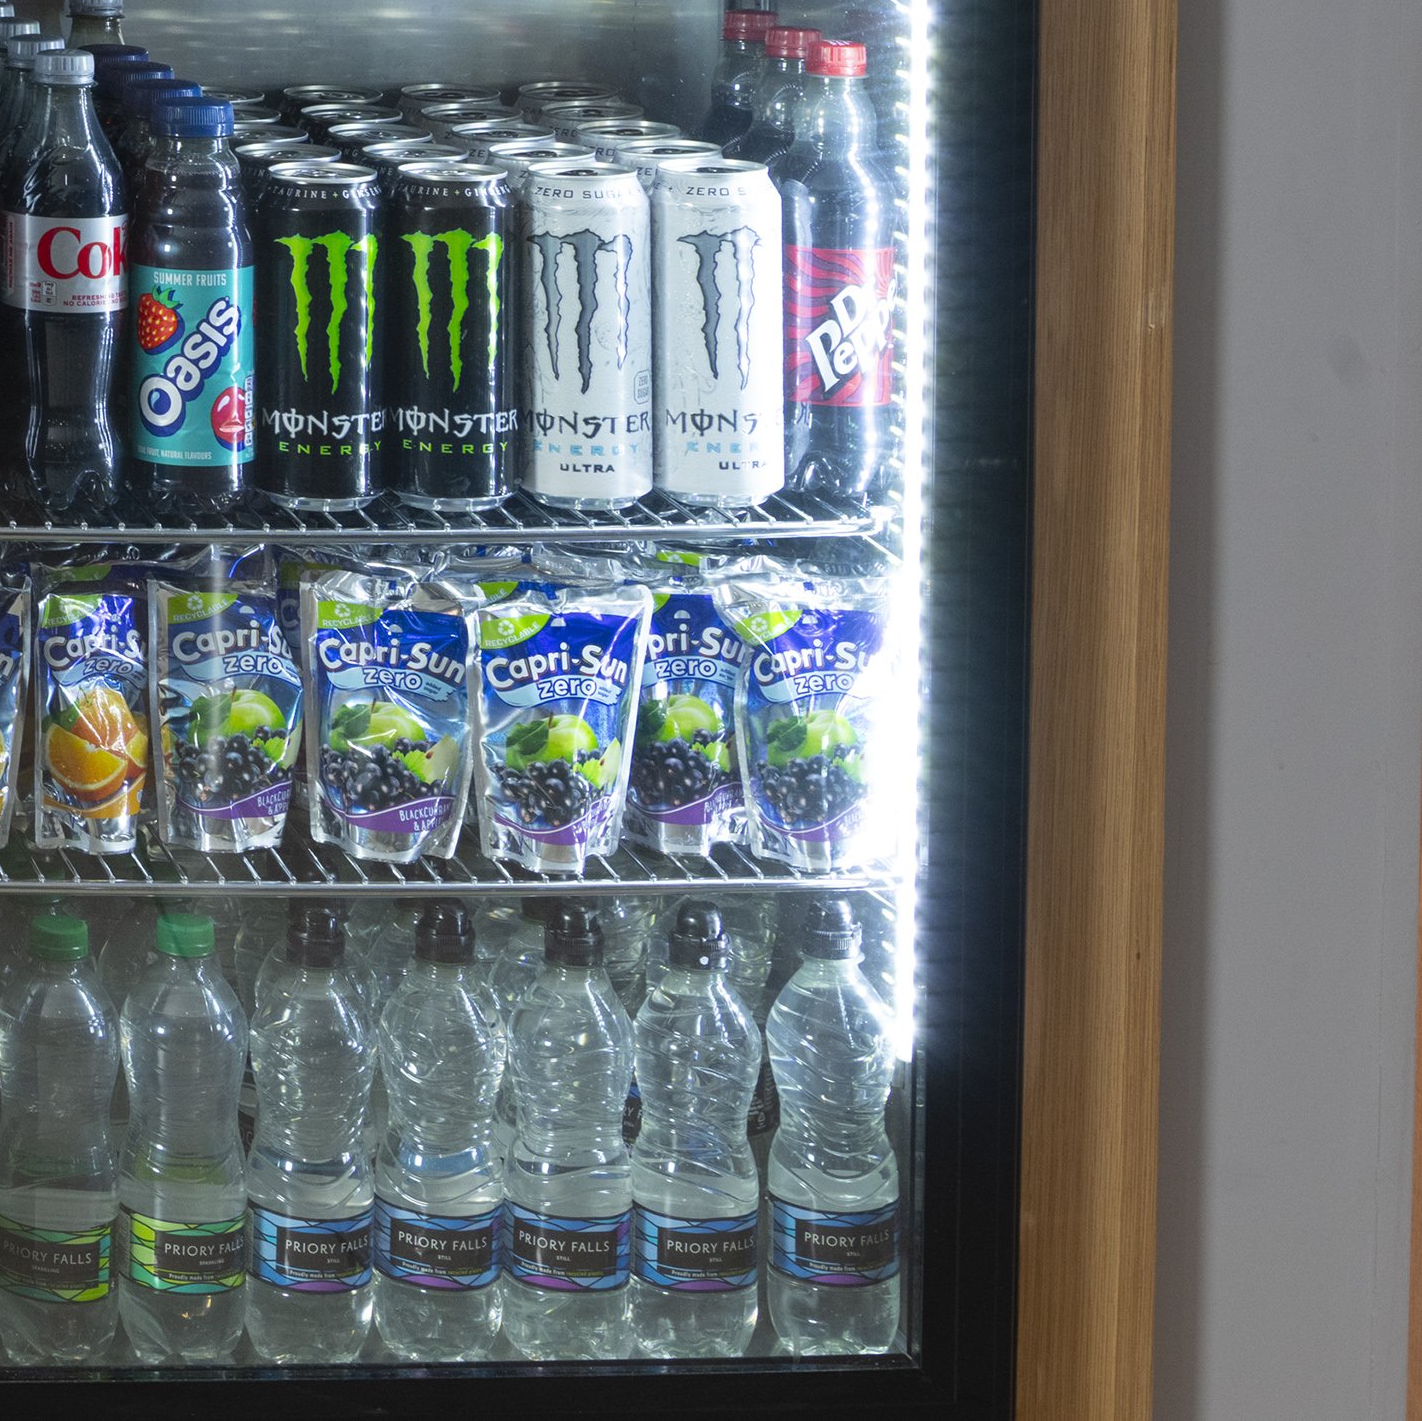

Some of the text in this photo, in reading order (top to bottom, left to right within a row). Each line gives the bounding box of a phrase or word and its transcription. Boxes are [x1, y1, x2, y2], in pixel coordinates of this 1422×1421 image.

[154, 272, 227, 286] SUMMER FRUITS
[140, 300, 240, 426] Oasis
[403, 439, 508, 454] ENERGY
[560, 464, 615, 473] ULTRA
[319, 637, 466, 684] Capri-Sun
[485, 641, 628, 690] Capri-Sun
[657, 658, 717, 679] zero
[363, 668, 422, 689] zero
[537, 677, 598, 698] zero
[164, 1236, 244, 1256] PRIORY FALLS
[285, 1237, 368, 1254] PRIORY FALLS
[398, 1231, 487, 1251] PRIORY FALLS
[519, 1230, 610, 1252] PRIORY FALLS
[667, 1235, 754, 1254] PRIORY FALLS
